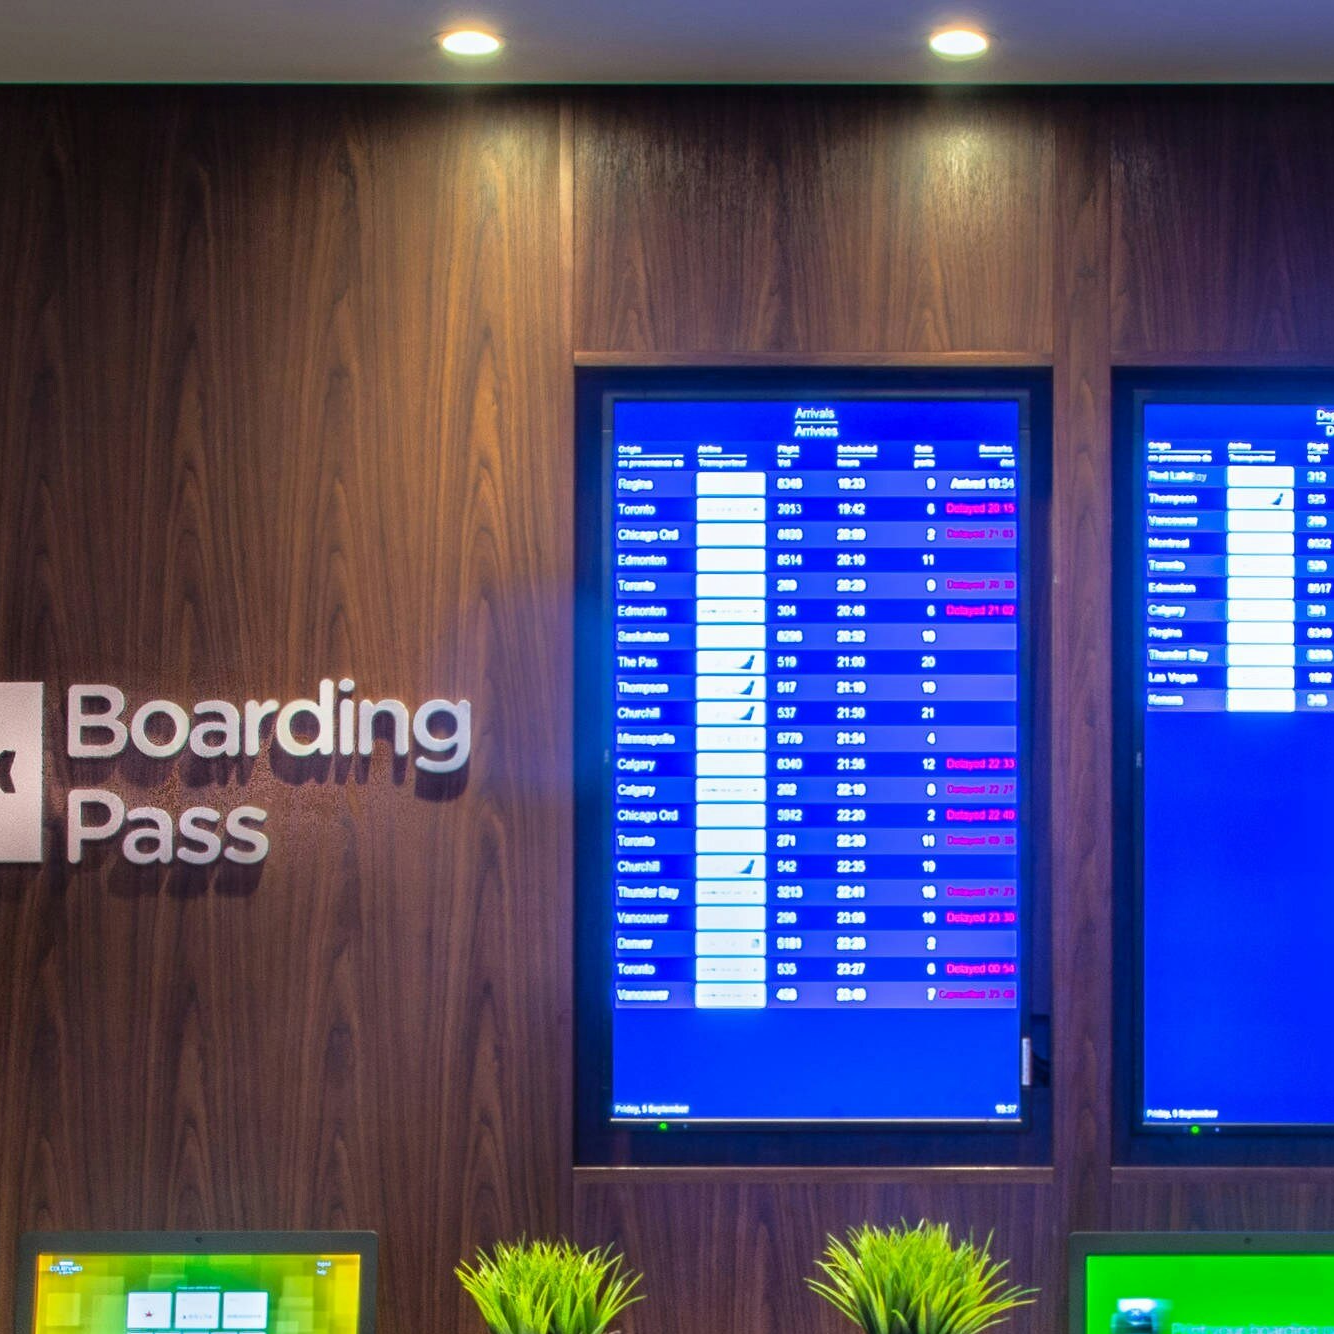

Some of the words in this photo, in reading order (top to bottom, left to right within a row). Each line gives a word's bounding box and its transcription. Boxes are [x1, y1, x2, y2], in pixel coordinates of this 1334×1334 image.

[795, 407, 835, 419] Arrivals
[794, 425, 839, 437] Arrivées
[618, 478, 654, 492] Regina
[617, 502, 656, 515] Toronto
[946, 503, 986, 515] Delayed
[617, 528, 659, 543] Chicago
[617, 554, 668, 566] Edmonton
[922, 553, 935, 566] 11
[617, 605, 667, 617] Edmonton
[946, 605, 986, 617] Delayed
[617, 655, 637, 668] The
[637, 655, 658, 668] Pas
[617, 681, 669, 696] Thompson
[616, 706, 661, 719] Churchill
[921, 706, 935, 719] 21
[67, 678, 471, 774] Boarding
[616, 758, 656, 772] Calgary
[922, 757, 936, 771] 12
[946, 758, 986, 771] Delayed
[617, 783, 656, 798] Calgary
[617, 809, 658, 824] Chicago
[658, 809, 679, 822] Ord
[927, 808, 936, 822] 2
[946, 809, 986, 822] Delayed
[67, 788, 269, 864] Pass
[616, 860, 661, 873] Churchill
[616, 912, 669, 924] Vancouver
[946, 912, 986, 924] Delayed
[946, 963, 986, 975] Delayed
